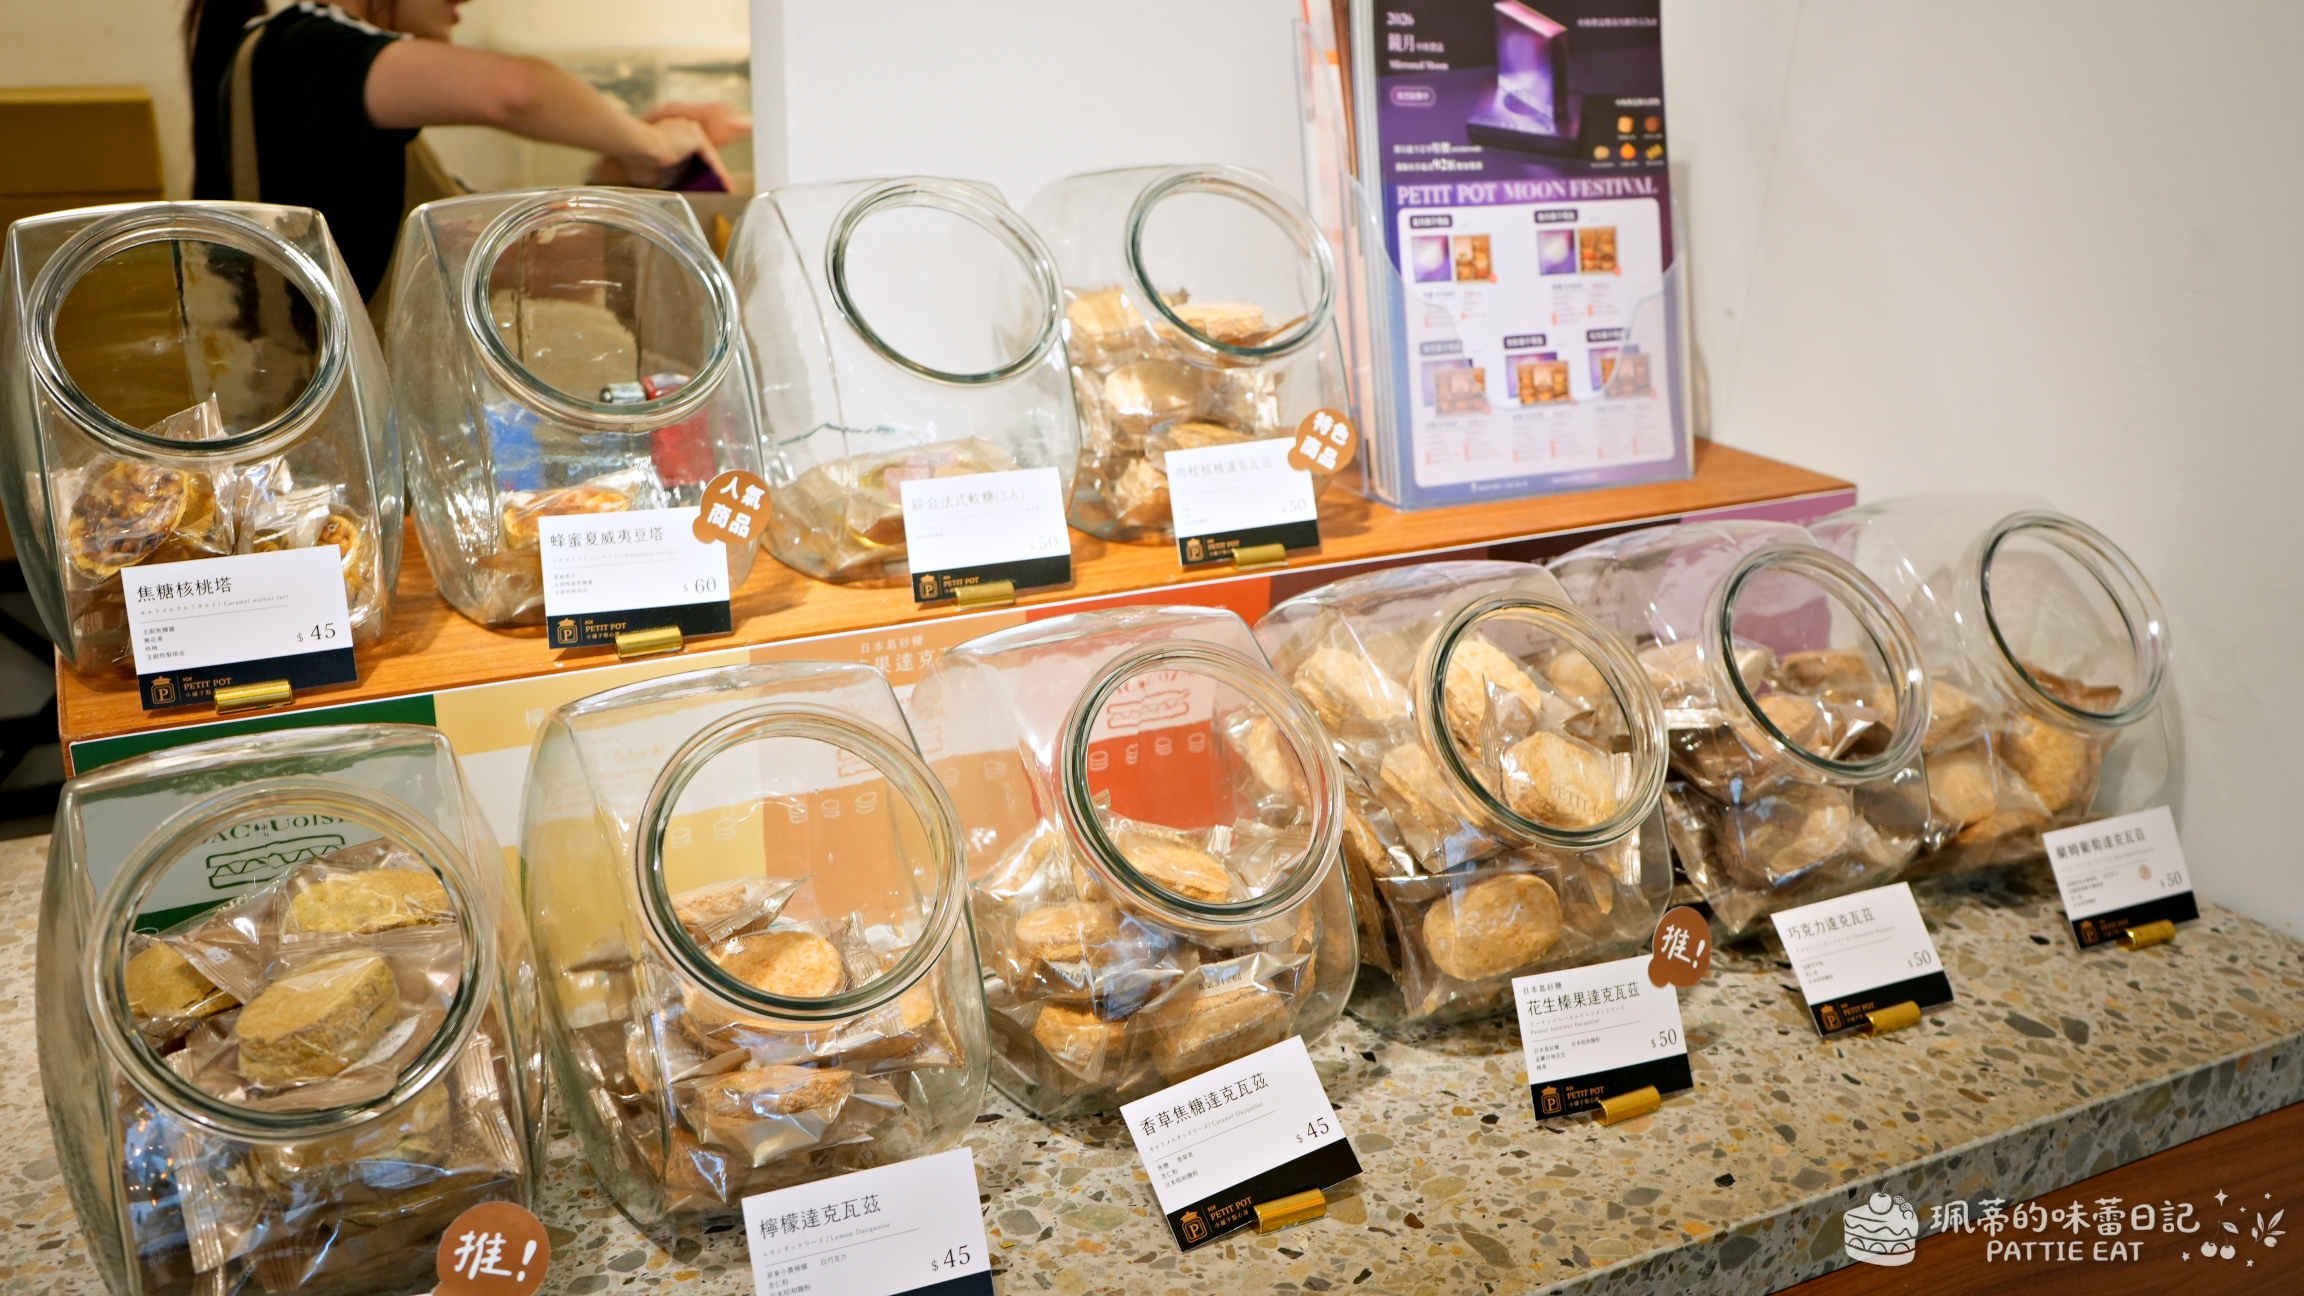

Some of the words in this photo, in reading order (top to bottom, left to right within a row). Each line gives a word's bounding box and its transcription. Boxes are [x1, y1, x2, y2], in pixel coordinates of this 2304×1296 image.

[1397, 185, 1452, 205] PETIT
[1457, 184, 1497, 204] POT
[1503, 180, 1566, 201] MOON
[1569, 177, 1657, 199] FESTIVAL
[1313, 412, 1349, 446] 特色
[1299, 435, 1338, 471] 商品
[720, 476, 765, 510] 人氣
[1287, 497, 1307, 512] 50
[707, 502, 751, 538] 商品
[550, 525, 664, 549] 蜂蜜夏威夷豆塔
[1038, 534, 1058, 549] 50
[135, 575, 233, 603] 焦糖核桃塔
[682, 582, 688, 592] $
[693, 576, 717, 593] 60
[223, 598, 250, 606] Caramel
[252, 595, 274, 603] walnut
[296, 632, 303, 642] $
[309, 622, 336, 640] 45
[584, 623, 608, 632] PETIT
[610, 621, 627, 629] POT
[183, 679, 211, 690] PETIT
[212, 676, 232, 686] POT
[158, 687, 169, 700] P
[1549, 782, 1590, 812] PETIT
[2165, 870, 2183, 887] 50
[1785, 906, 1876, 941] 巧克力達克瓦茲
[1912, 949, 1933, 966] 50
[1522, 981, 1562, 995] 日本島砂糖
[1526, 980, 1640, 1017] 花生榛果達克瓦茲
[1530, 1027, 1548, 1035] Peanut
[1550, 1022, 1573, 1031] hazelnut
[1650, 1038, 1656, 1048] $
[1657, 1028, 1678, 1047] 50
[1566, 1088, 1589, 1100] PETIT
[1589, 1085, 1604, 1094] POT
[1137, 1070, 1269, 1138] 香草焦糖達克瓦茲
[1210, 1112, 1235, 1126] Caramel
[1234, 1100, 1264, 1117] Dacquoise
[1546, 1097, 1556, 1111] P
[1294, 1132, 1304, 1144] $
[1303, 1116, 1330, 1140] 45
[757, 1193, 881, 1239] 檸檬達克瓦茲
[1209, 1204, 1235, 1221] PETIT
[1234, 1196, 1253, 1209] POT
[830, 1230, 853, 1241] Lemon
[855, 1221, 890, 1235] Dacquoise
[1188, 1222, 1202, 1238] P
[454, 1230, 537, 1282] 推!
[820, 1253, 847, 1265] 白巧克力
[930, 1259, 939, 1271] $
[941, 1244, 971, 1269] 45
[767, 1278, 789, 1289] 杏仁粉
